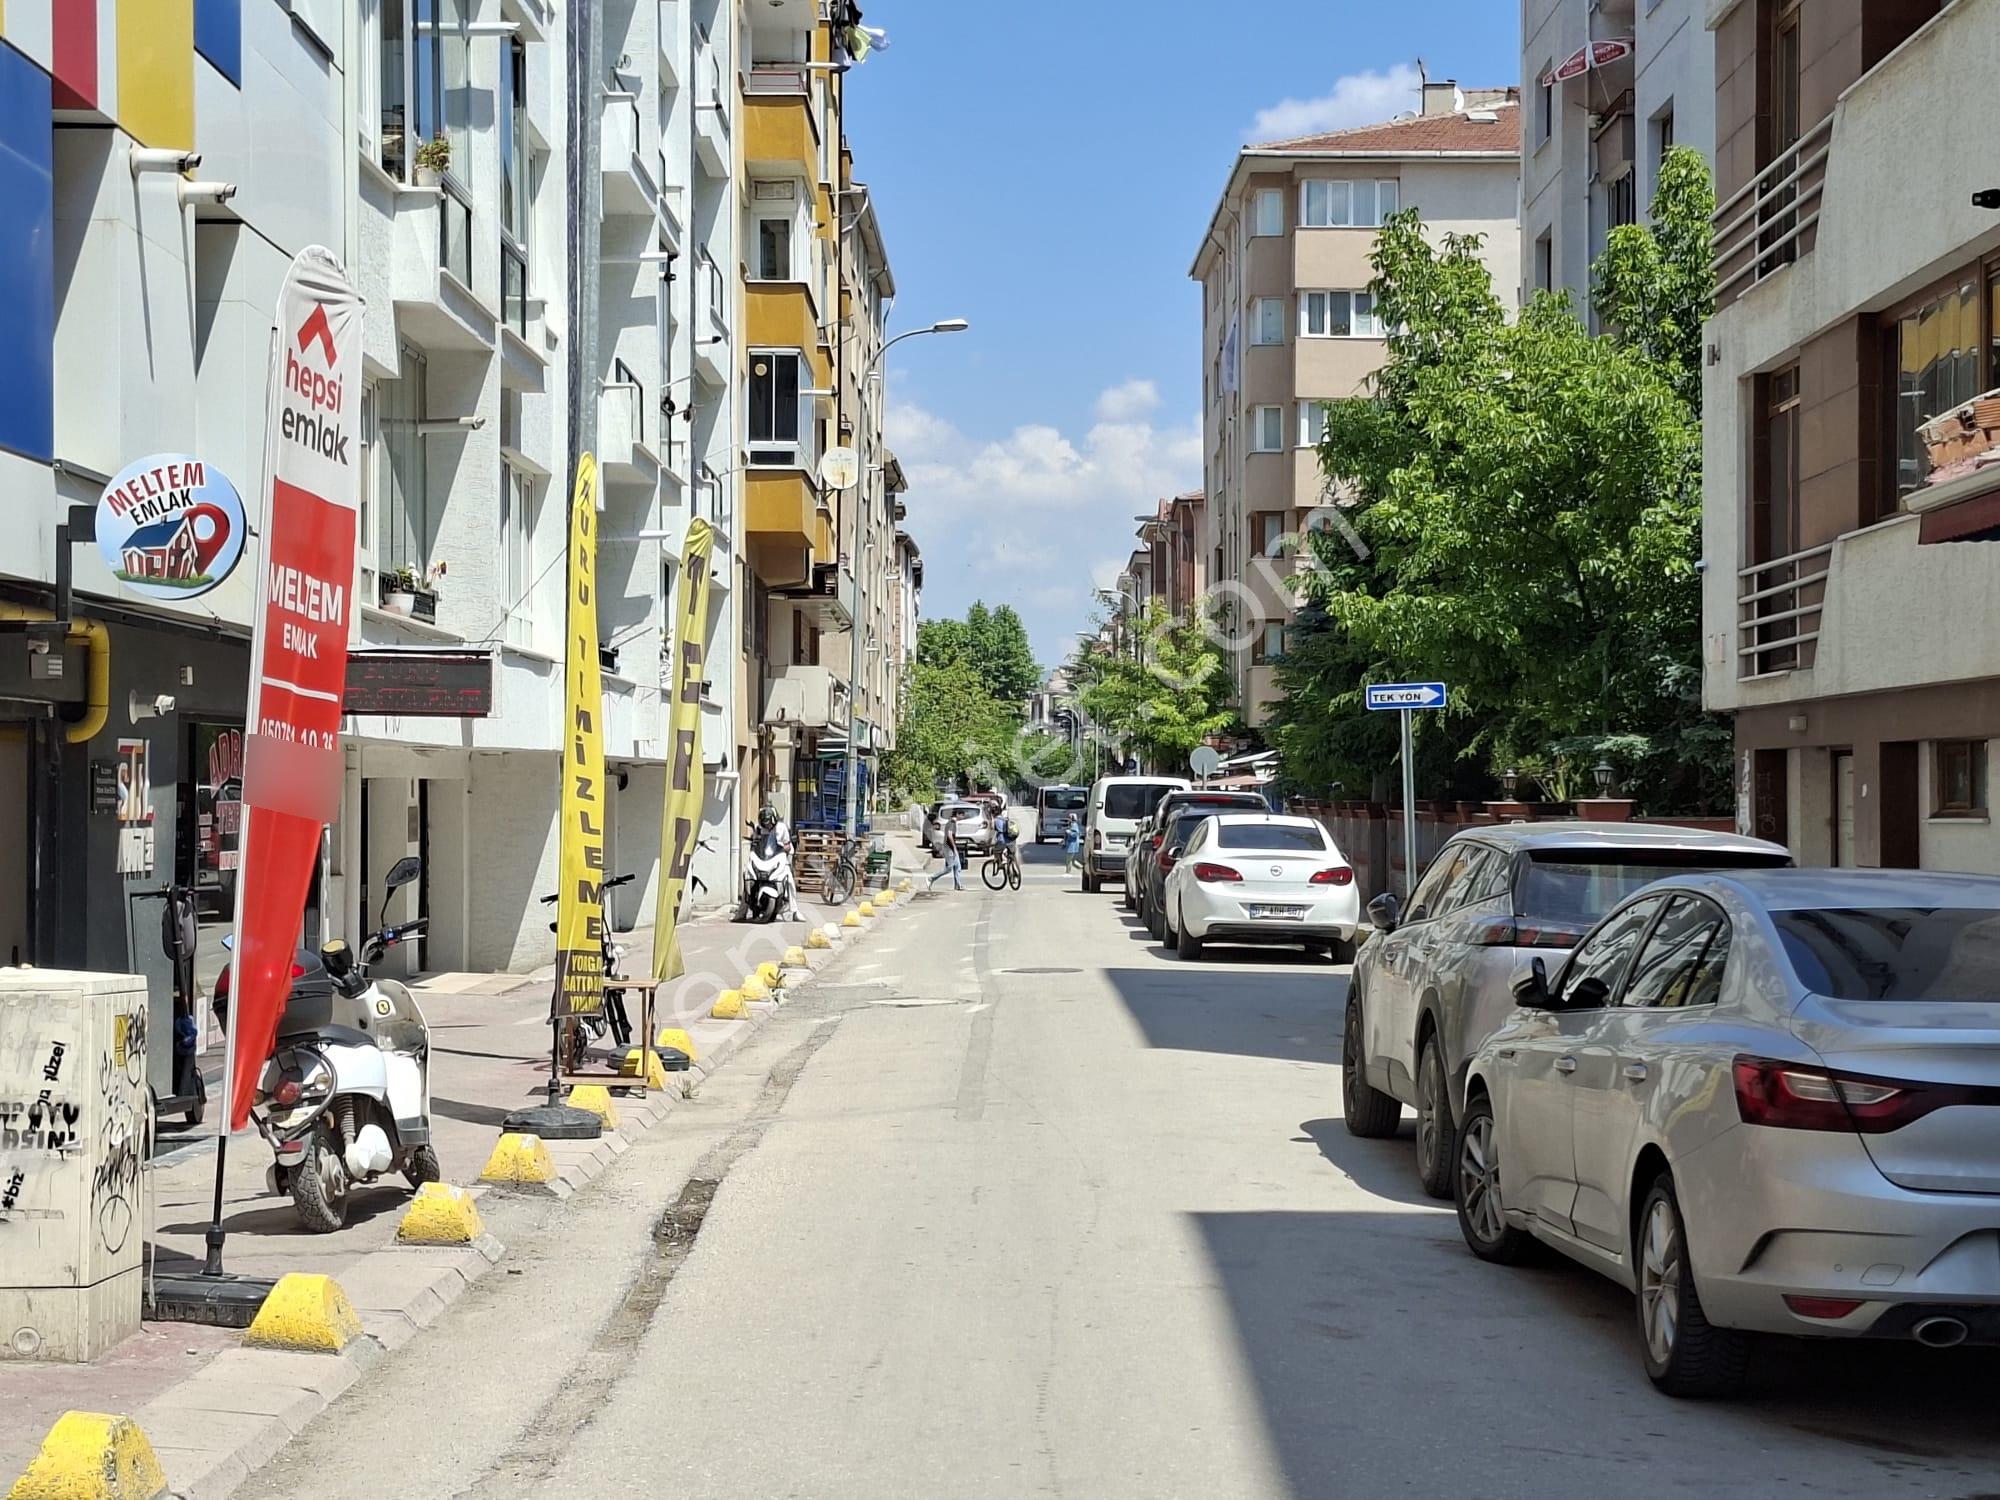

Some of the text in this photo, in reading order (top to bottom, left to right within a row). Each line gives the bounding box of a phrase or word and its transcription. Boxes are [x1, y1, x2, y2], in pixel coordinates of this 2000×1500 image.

[285, 347, 342, 414] hepsi
[282, 407, 349, 466] emlak
[106, 462, 205, 517] MELTEM
[129, 487, 195, 527] EMLAK
[268, 563, 343, 626] MELTEM
[1373, 694, 1394, 702] TEK
[575, 634, 603, 941] TMİZLEME
